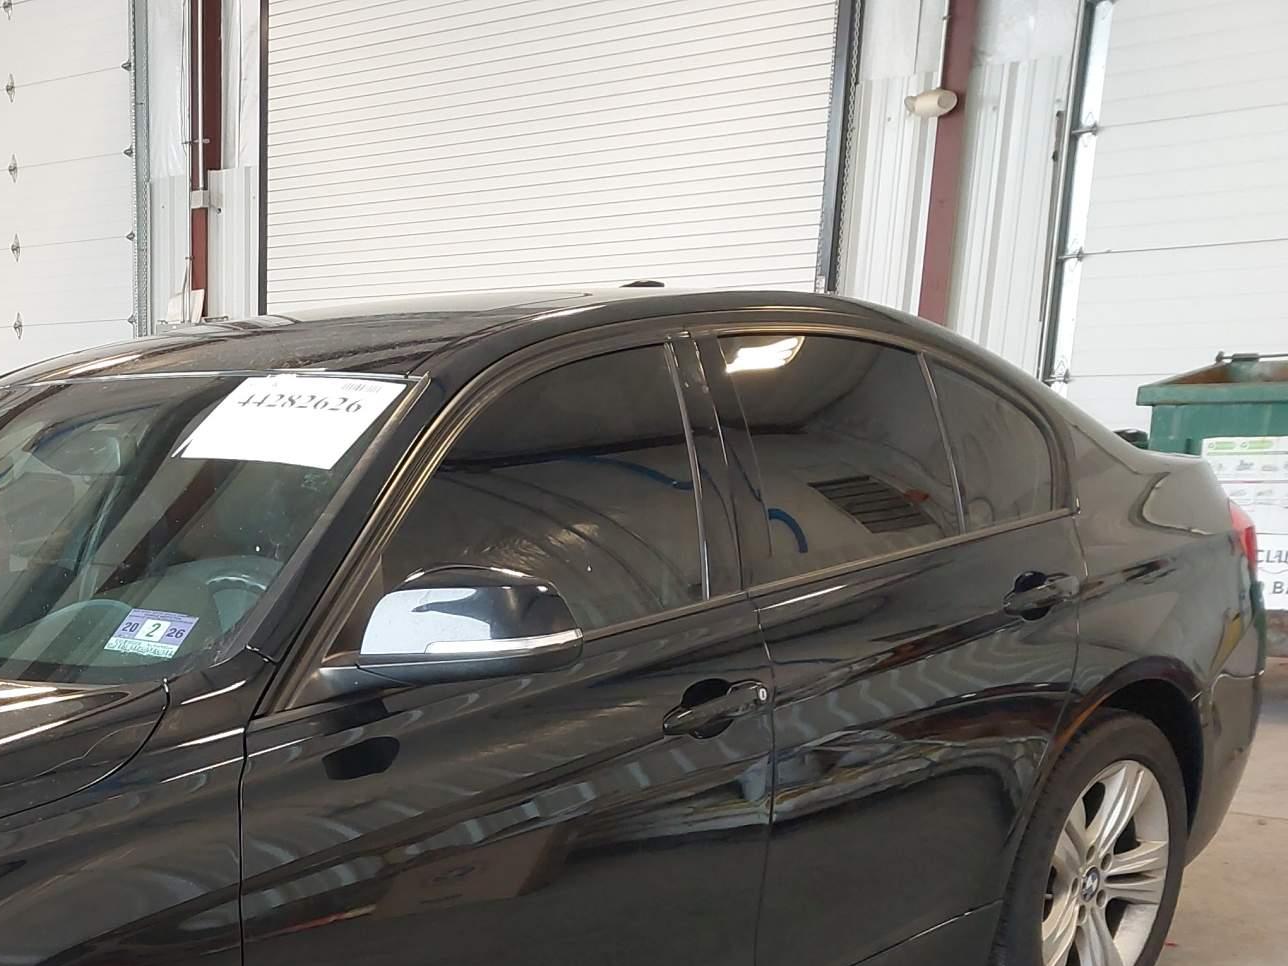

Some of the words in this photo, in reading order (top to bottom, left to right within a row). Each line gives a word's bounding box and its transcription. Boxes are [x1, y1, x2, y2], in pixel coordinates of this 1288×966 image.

[238, 393, 362, 413] 44282626
[122, 622, 139, 633] 20
[145, 623, 161, 638] 2
[166, 628, 185, 639] 26
